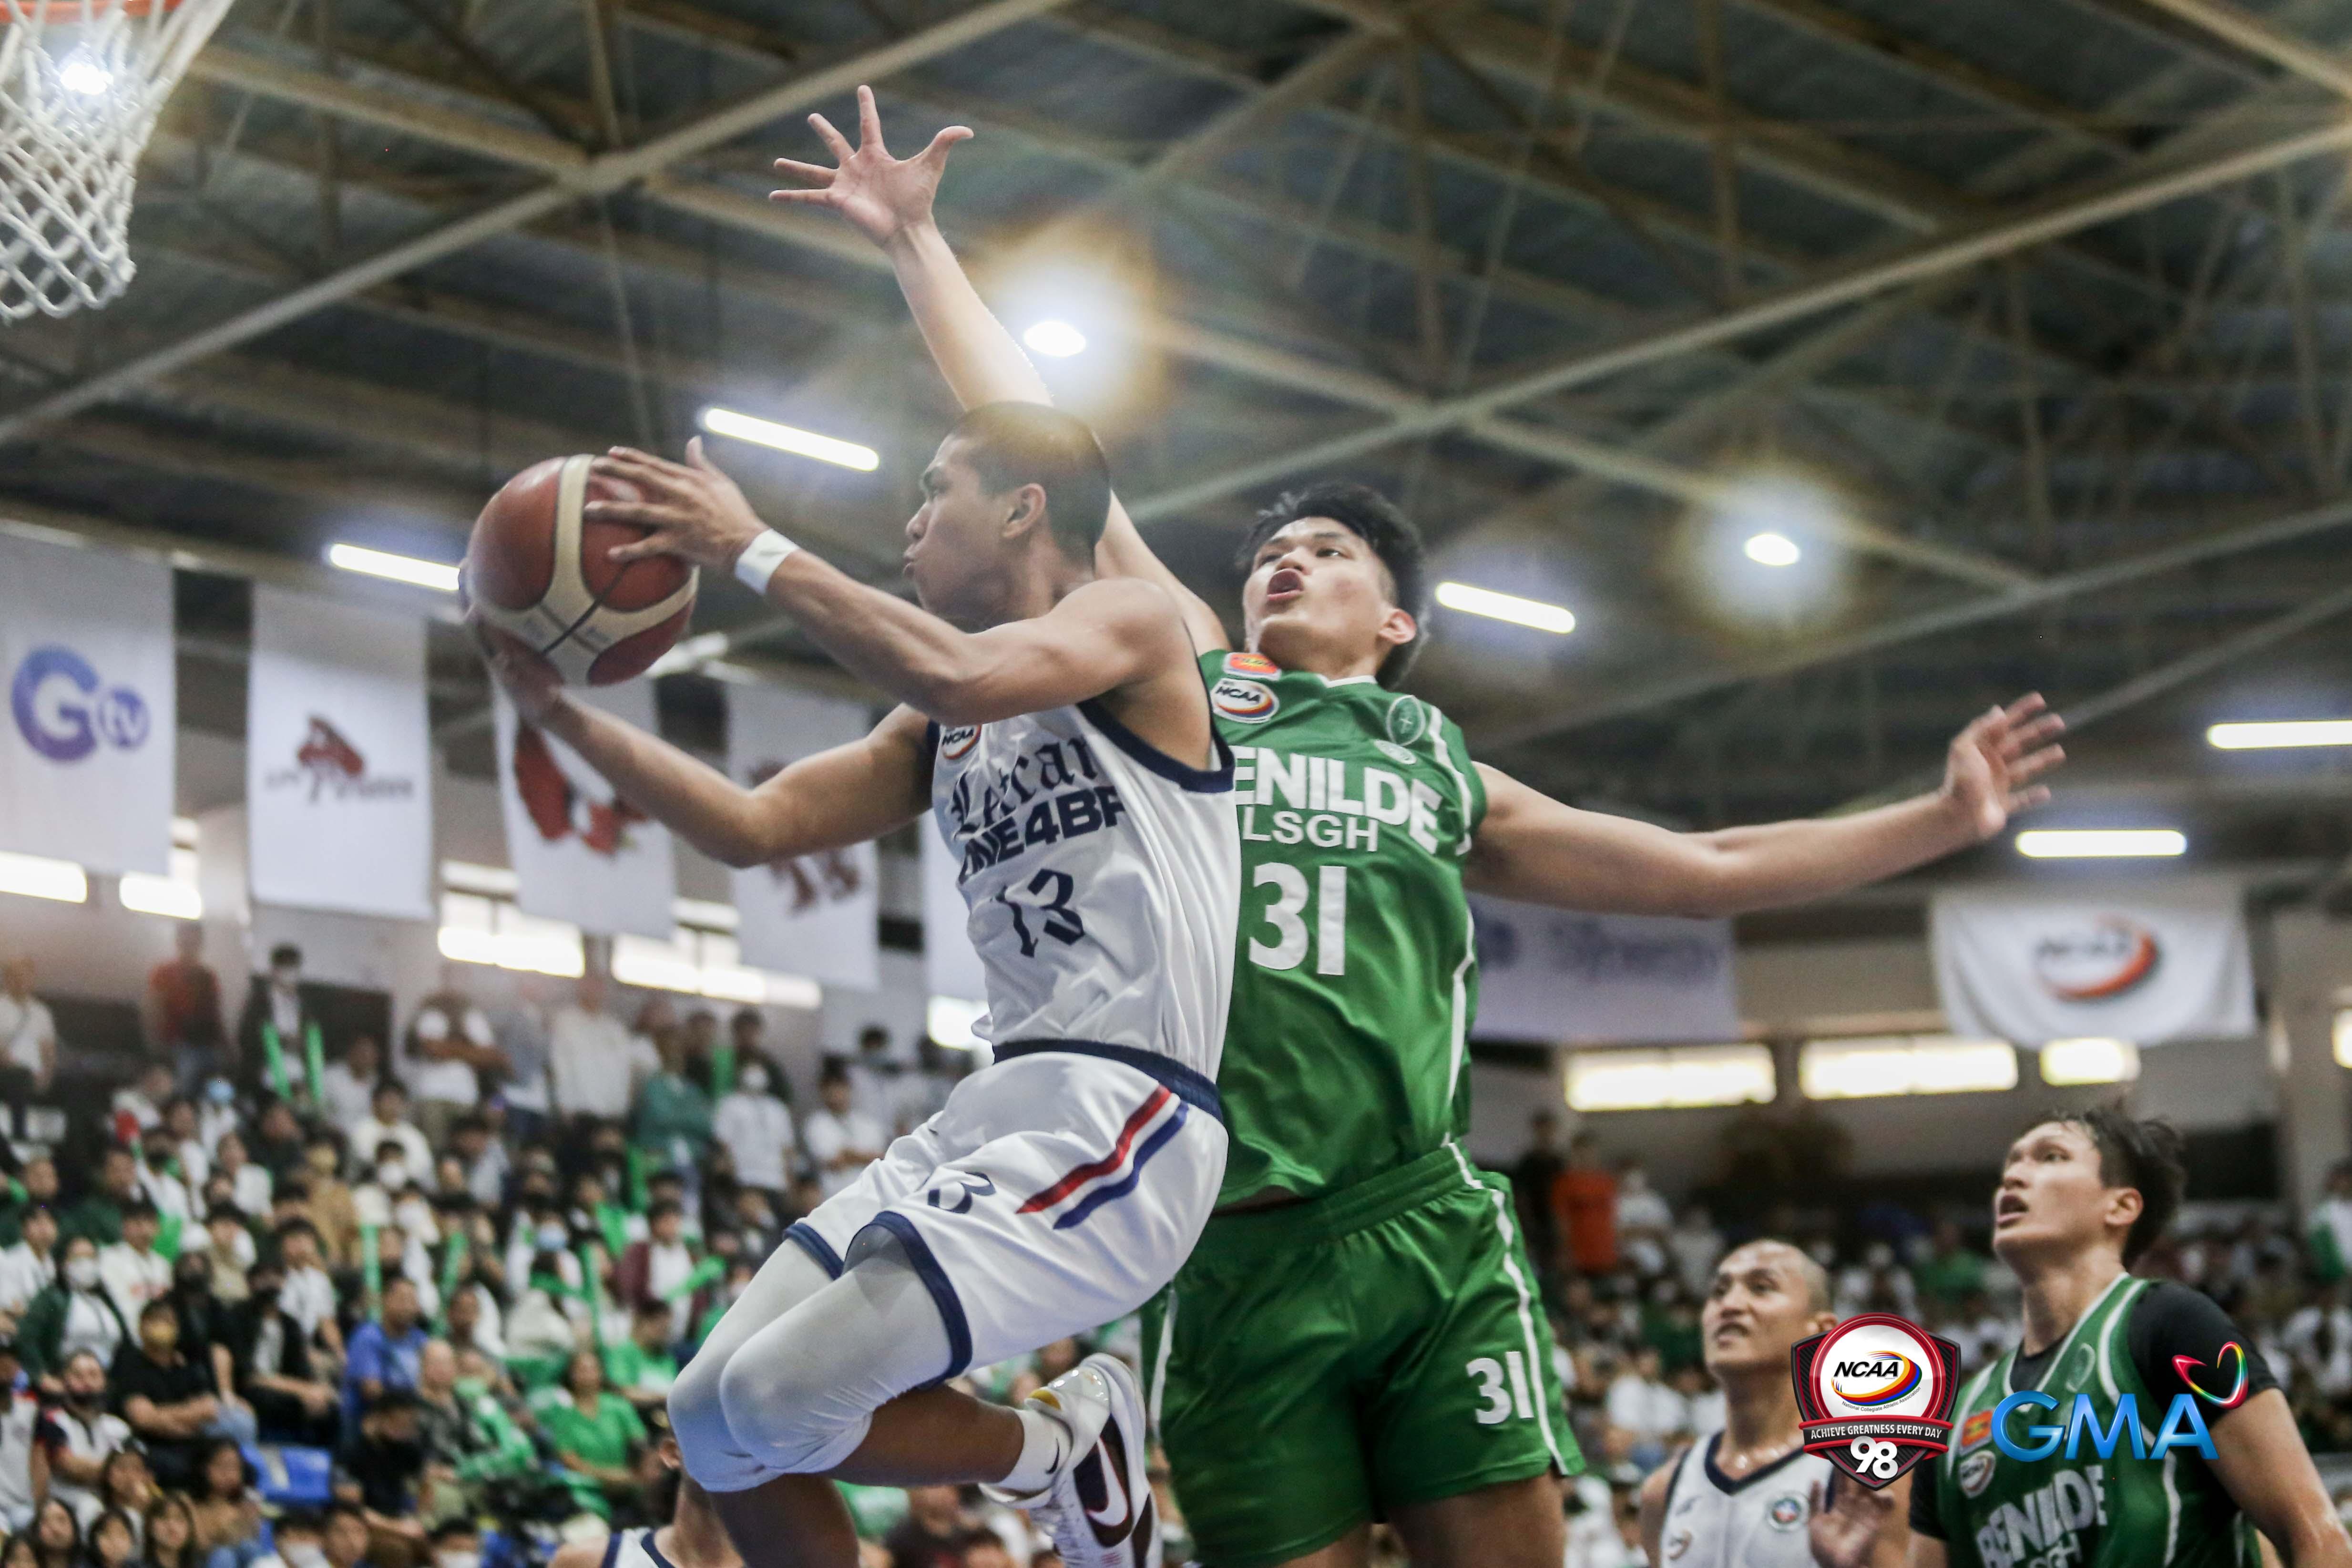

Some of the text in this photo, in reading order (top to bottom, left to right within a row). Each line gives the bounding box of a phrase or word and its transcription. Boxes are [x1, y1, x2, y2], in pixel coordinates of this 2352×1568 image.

[1216, 686, 1261, 703] NCAA
[942, 728, 974, 747] NCAA
[1232, 745, 1443, 854] ENILDE
[1243, 807, 1379, 852] LSGH
[990, 868, 1085, 958] 13
[1249, 862, 1348, 976] 31
[1466, 1351, 1534, 1425] 31
